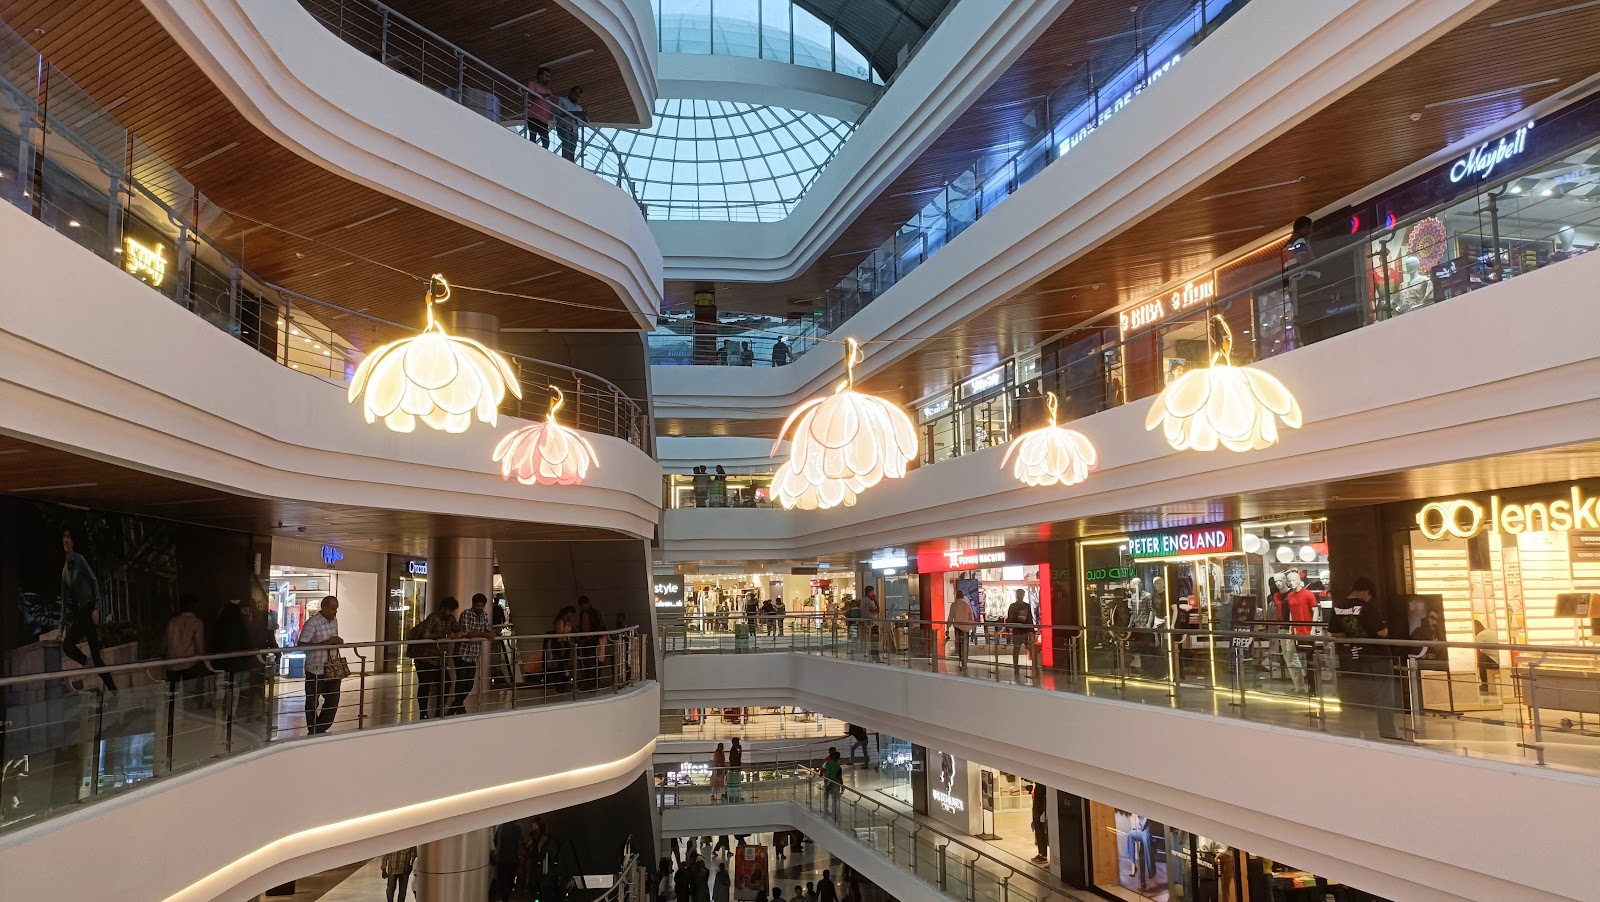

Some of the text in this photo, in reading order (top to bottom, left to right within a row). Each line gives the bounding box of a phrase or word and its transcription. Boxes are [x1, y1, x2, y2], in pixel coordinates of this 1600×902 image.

[1450, 126, 1527, 183] Maybell
[1131, 299, 1165, 330] BIBA
[1129, 530, 1226, 555] PETER ENGLAND
[409, 560, 428, 574] Crocod
[959, 552, 1006, 565] FLYING MACHINE
[654, 583, 679, 595] style
